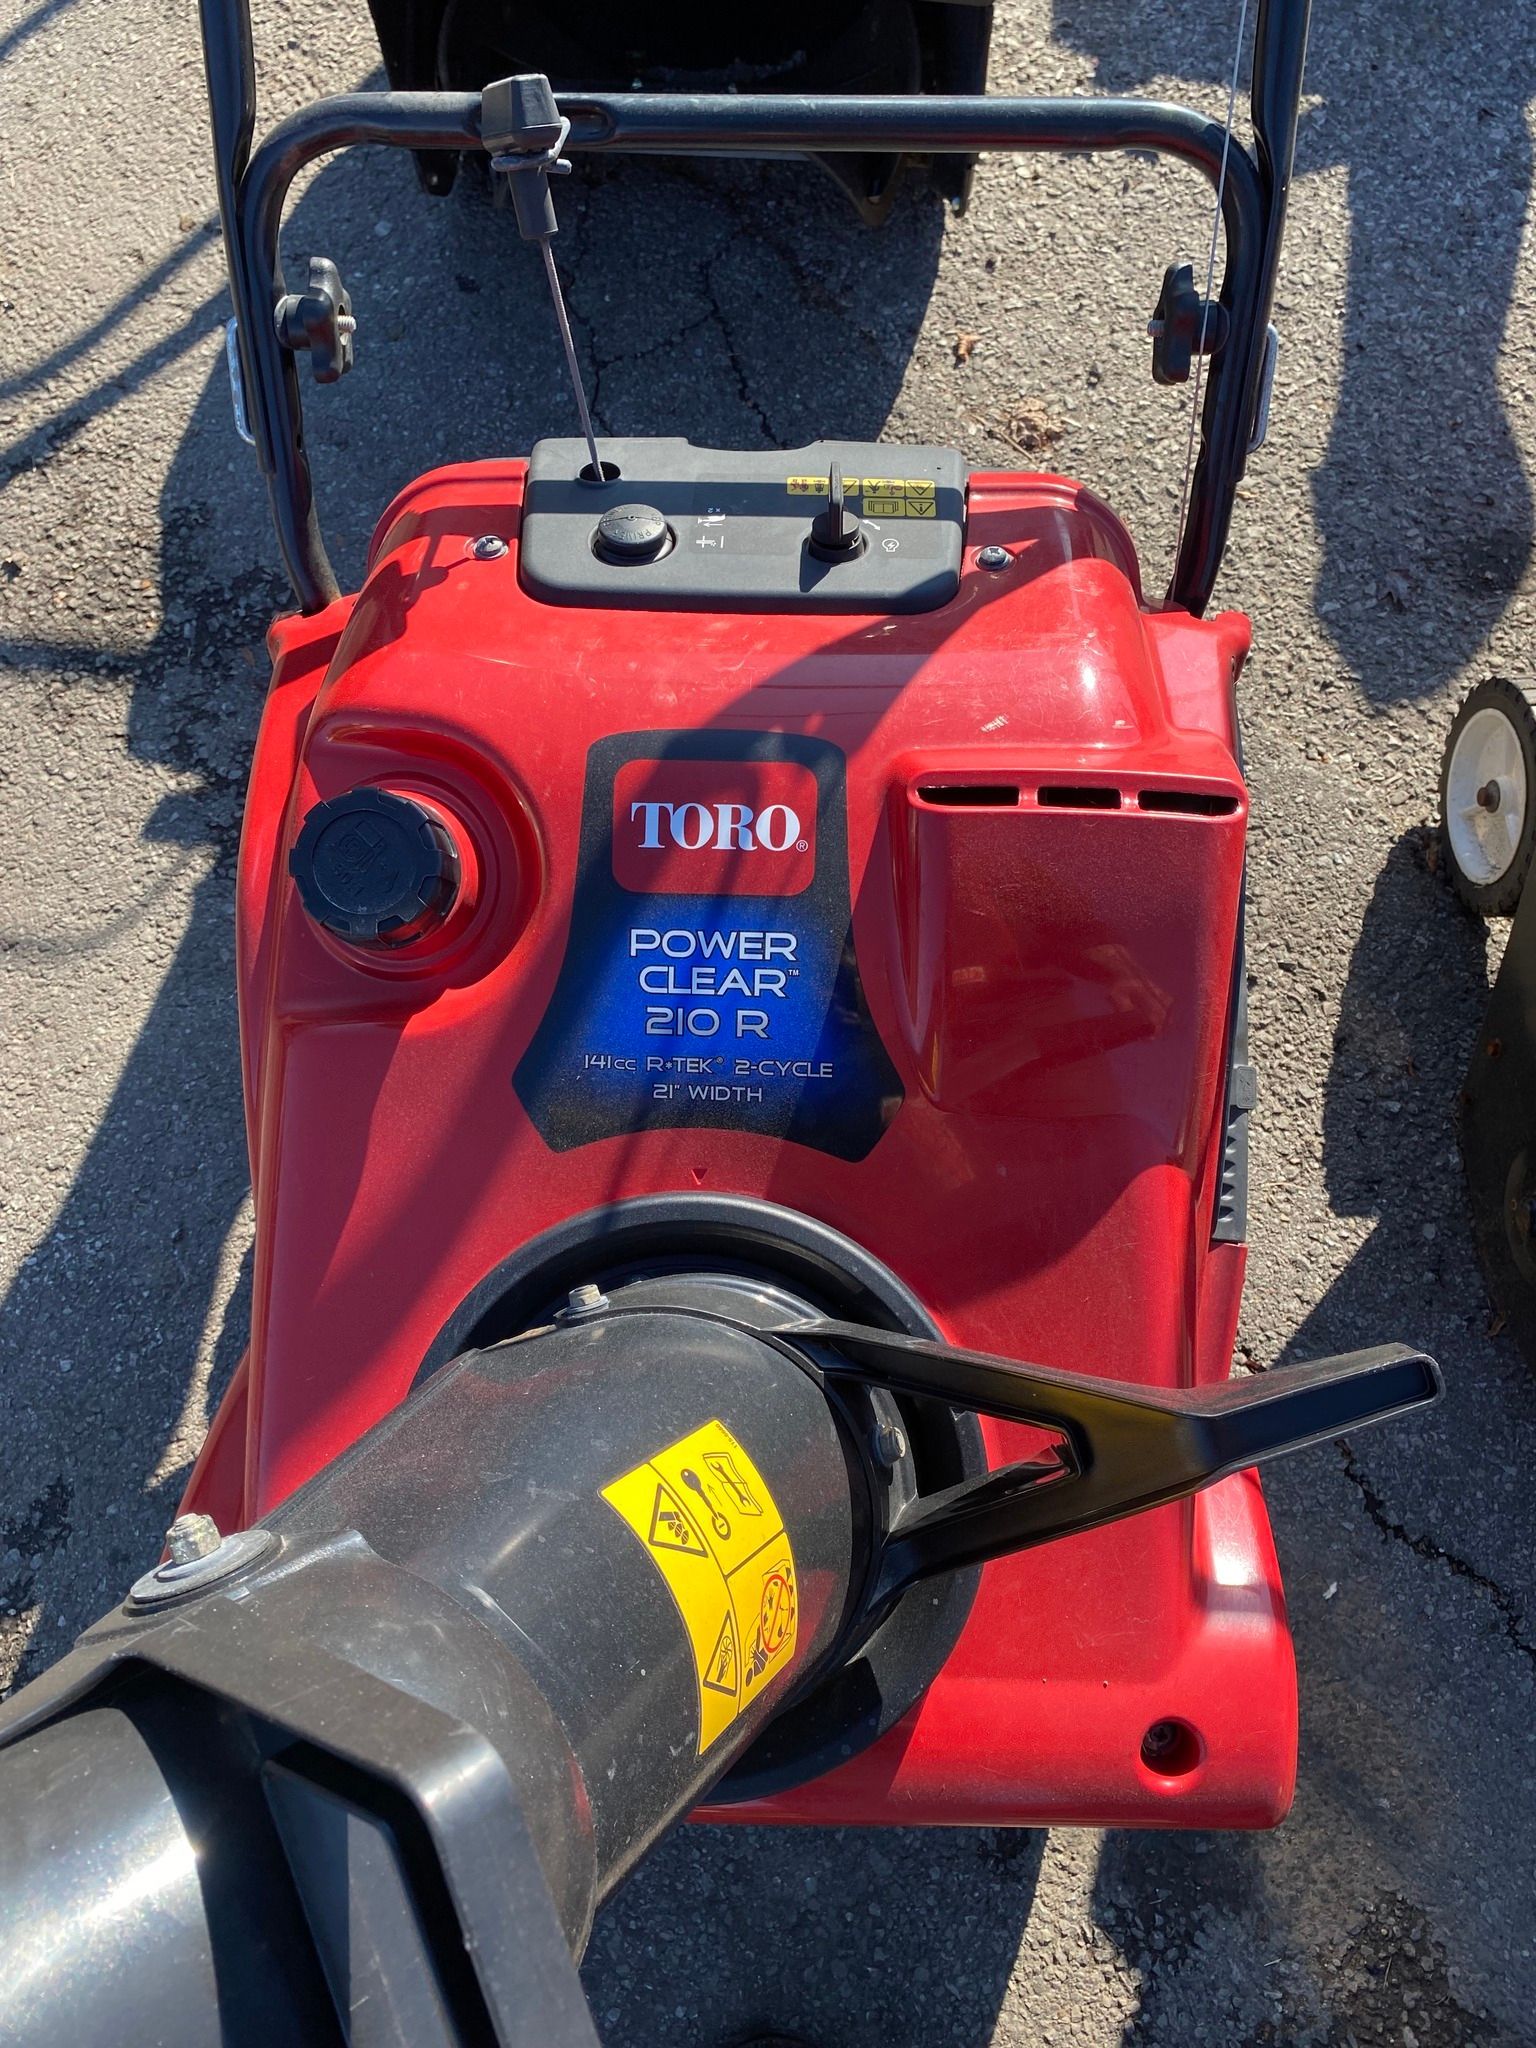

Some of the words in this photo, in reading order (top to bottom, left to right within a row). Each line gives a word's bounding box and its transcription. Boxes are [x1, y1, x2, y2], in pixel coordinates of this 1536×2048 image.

[630, 928, 798, 961] POWER
[645, 1006, 720, 1037] 210
[736, 1009, 769, 1039] R
[584, 1054, 636, 1071] 141cc
[735, 1059, 833, 1078] 2-CYCLE
[653, 1084, 680, 1100] 21"
[688, 1085, 763, 1103] WIDTH
